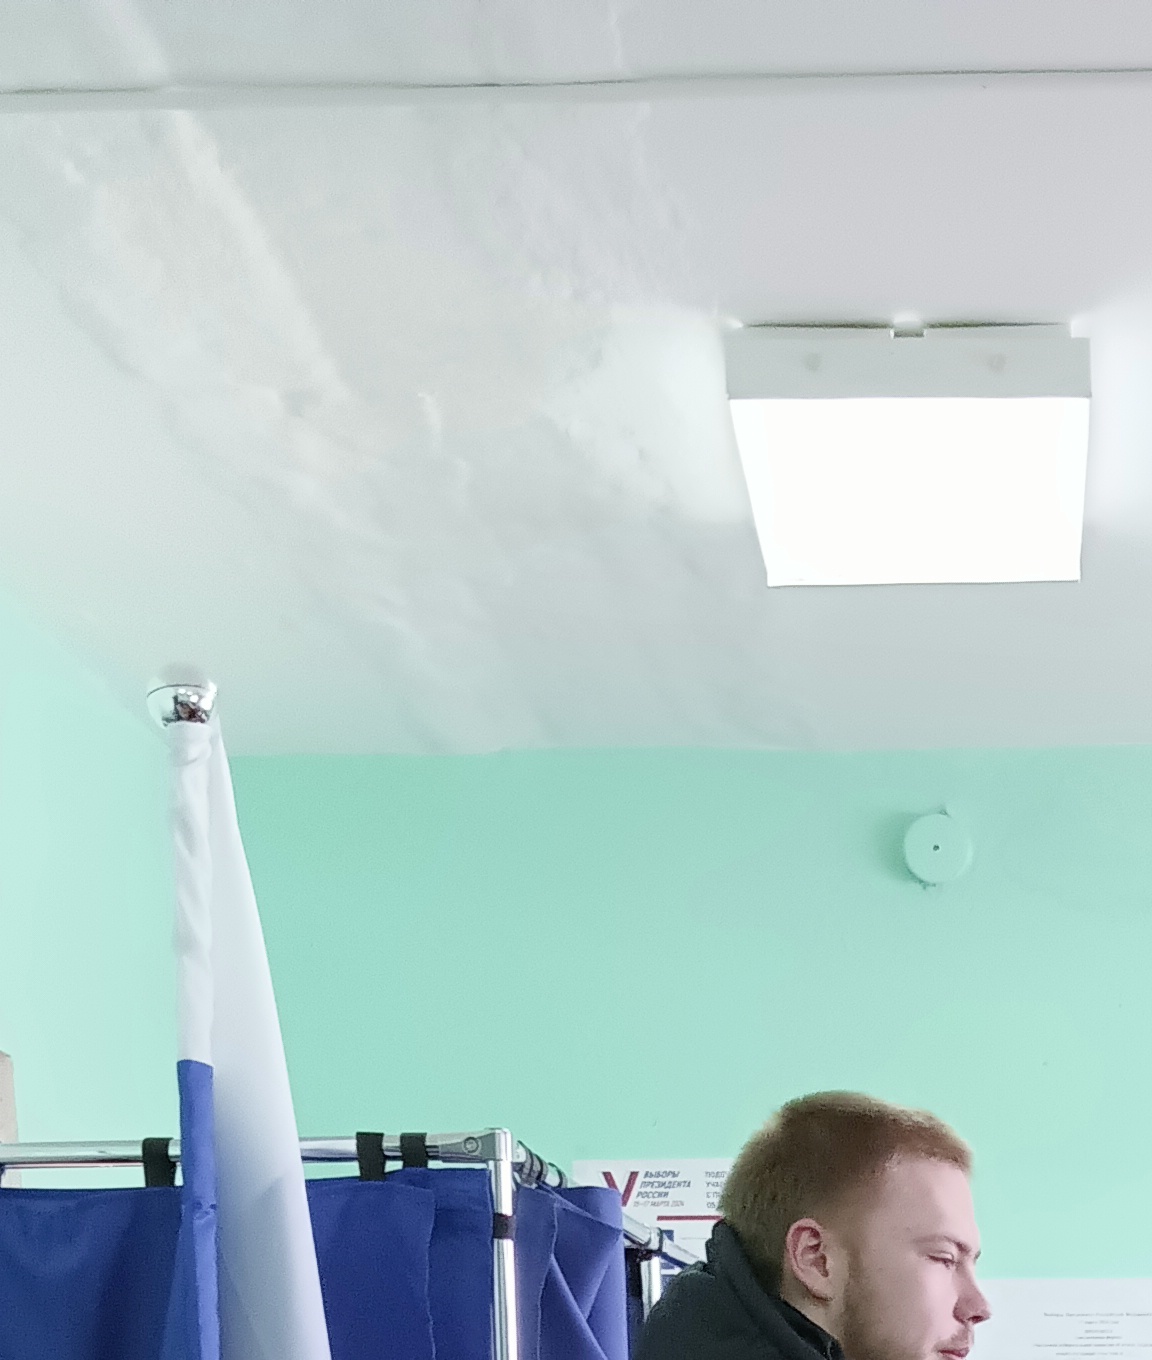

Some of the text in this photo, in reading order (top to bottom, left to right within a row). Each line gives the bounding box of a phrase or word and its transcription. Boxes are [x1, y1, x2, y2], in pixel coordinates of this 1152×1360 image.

[643, 1170, 681, 1179] ВЫБОРЫ
[639, 1180, 692, 1189] ПРЕЗИДЕНТА
[636, 1191, 670, 1199] РОССИИ
